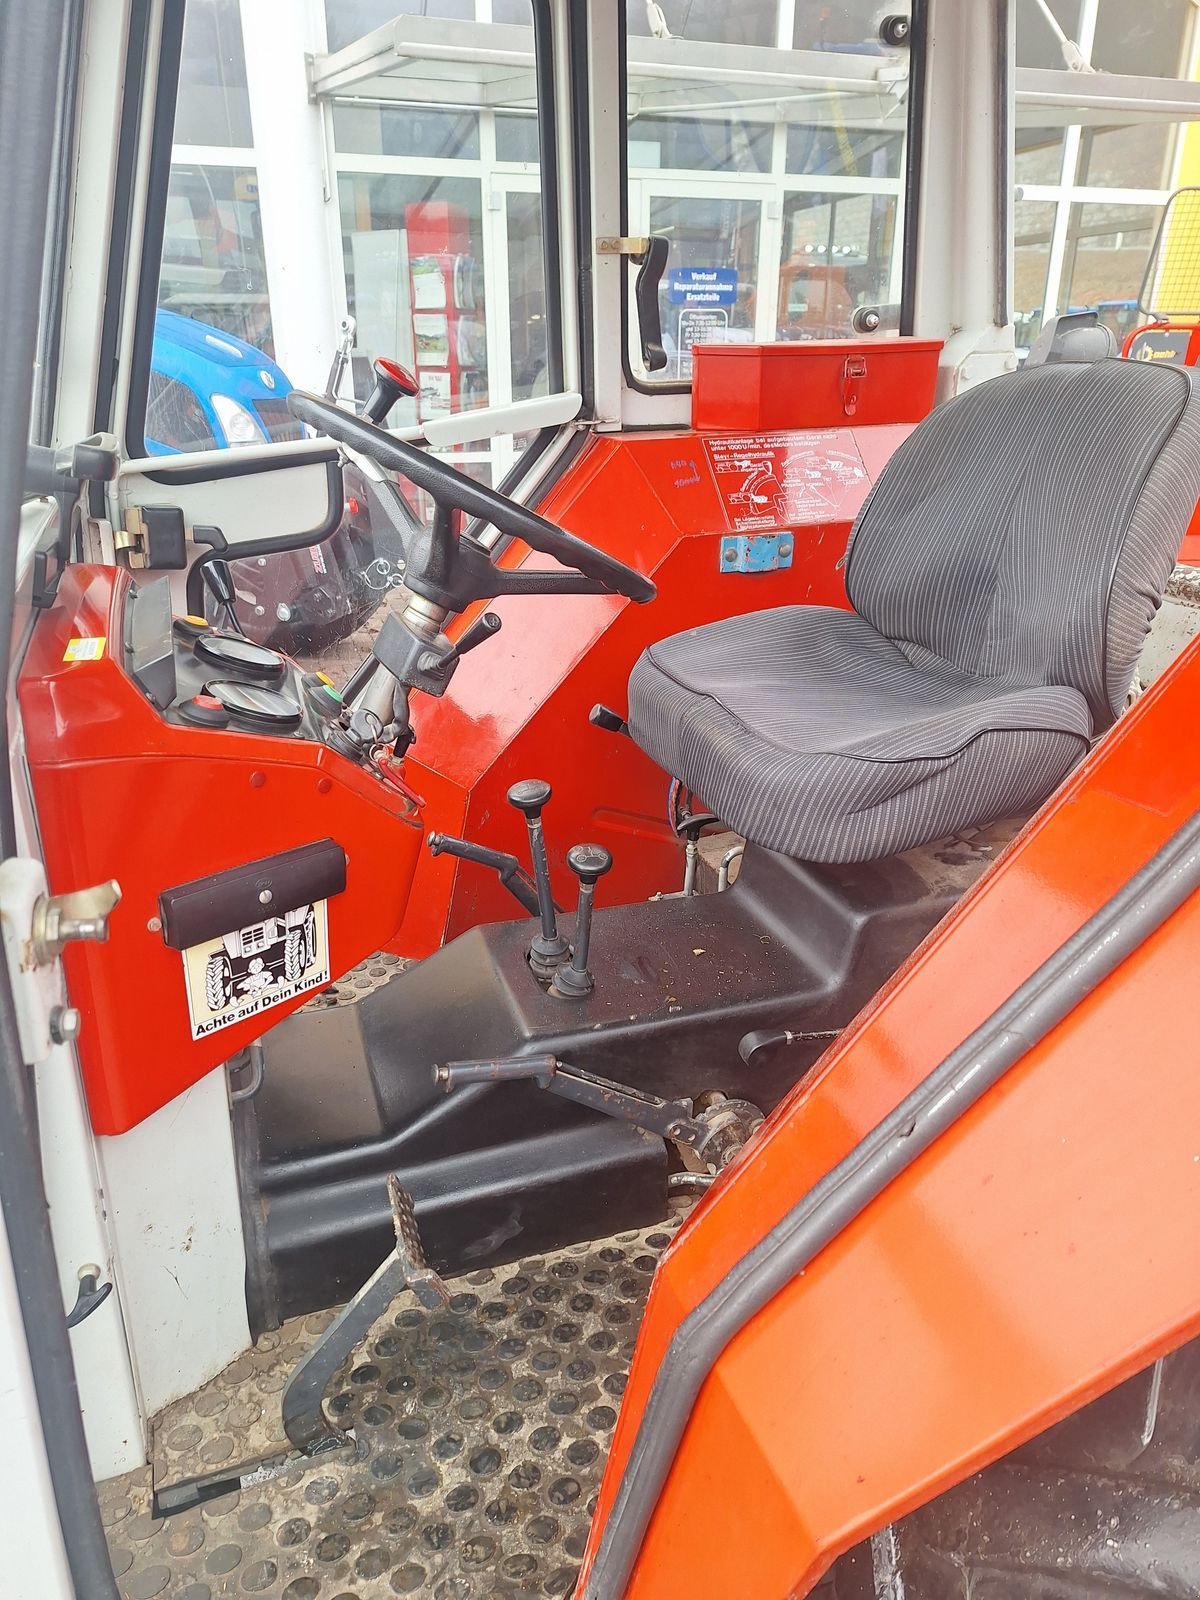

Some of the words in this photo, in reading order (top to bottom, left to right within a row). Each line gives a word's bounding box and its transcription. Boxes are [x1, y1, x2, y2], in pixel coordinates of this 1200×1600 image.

[691, 272, 717, 281] Verkauf
[196, 1013, 235, 1036] Achte
[238, 1001, 260, 1018] auf
[262, 988, 292, 1007] Dein
